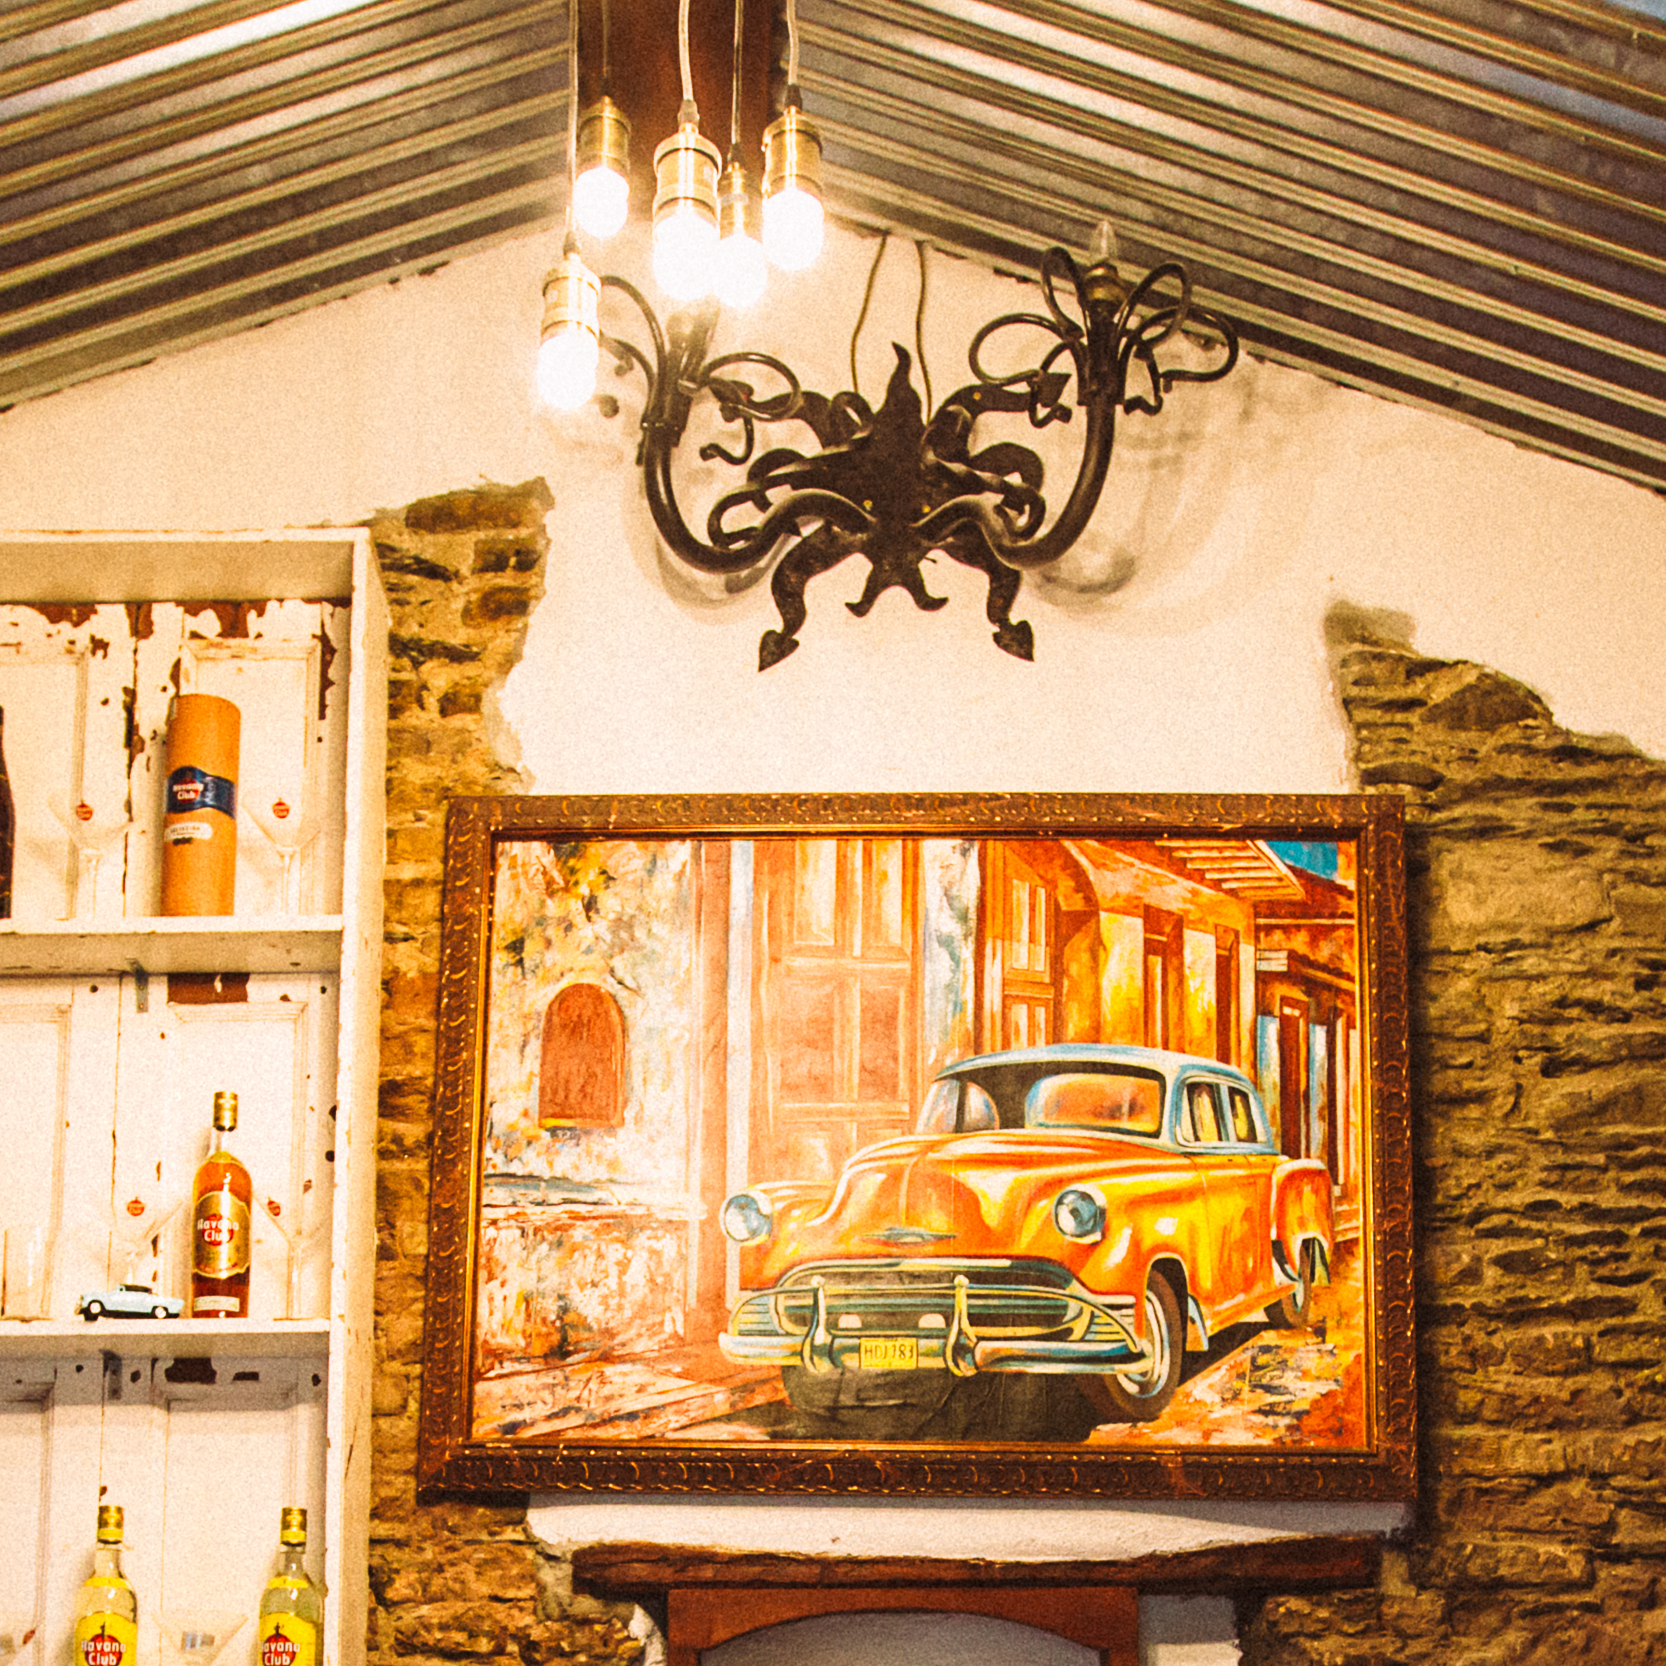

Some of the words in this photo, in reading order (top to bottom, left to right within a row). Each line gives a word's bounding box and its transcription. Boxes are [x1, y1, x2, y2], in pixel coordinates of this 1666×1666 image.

[81, 1640, 126, 1653] Havana
[88, 1652, 117, 1666] Club
[264, 1652, 290, 1666] Club
